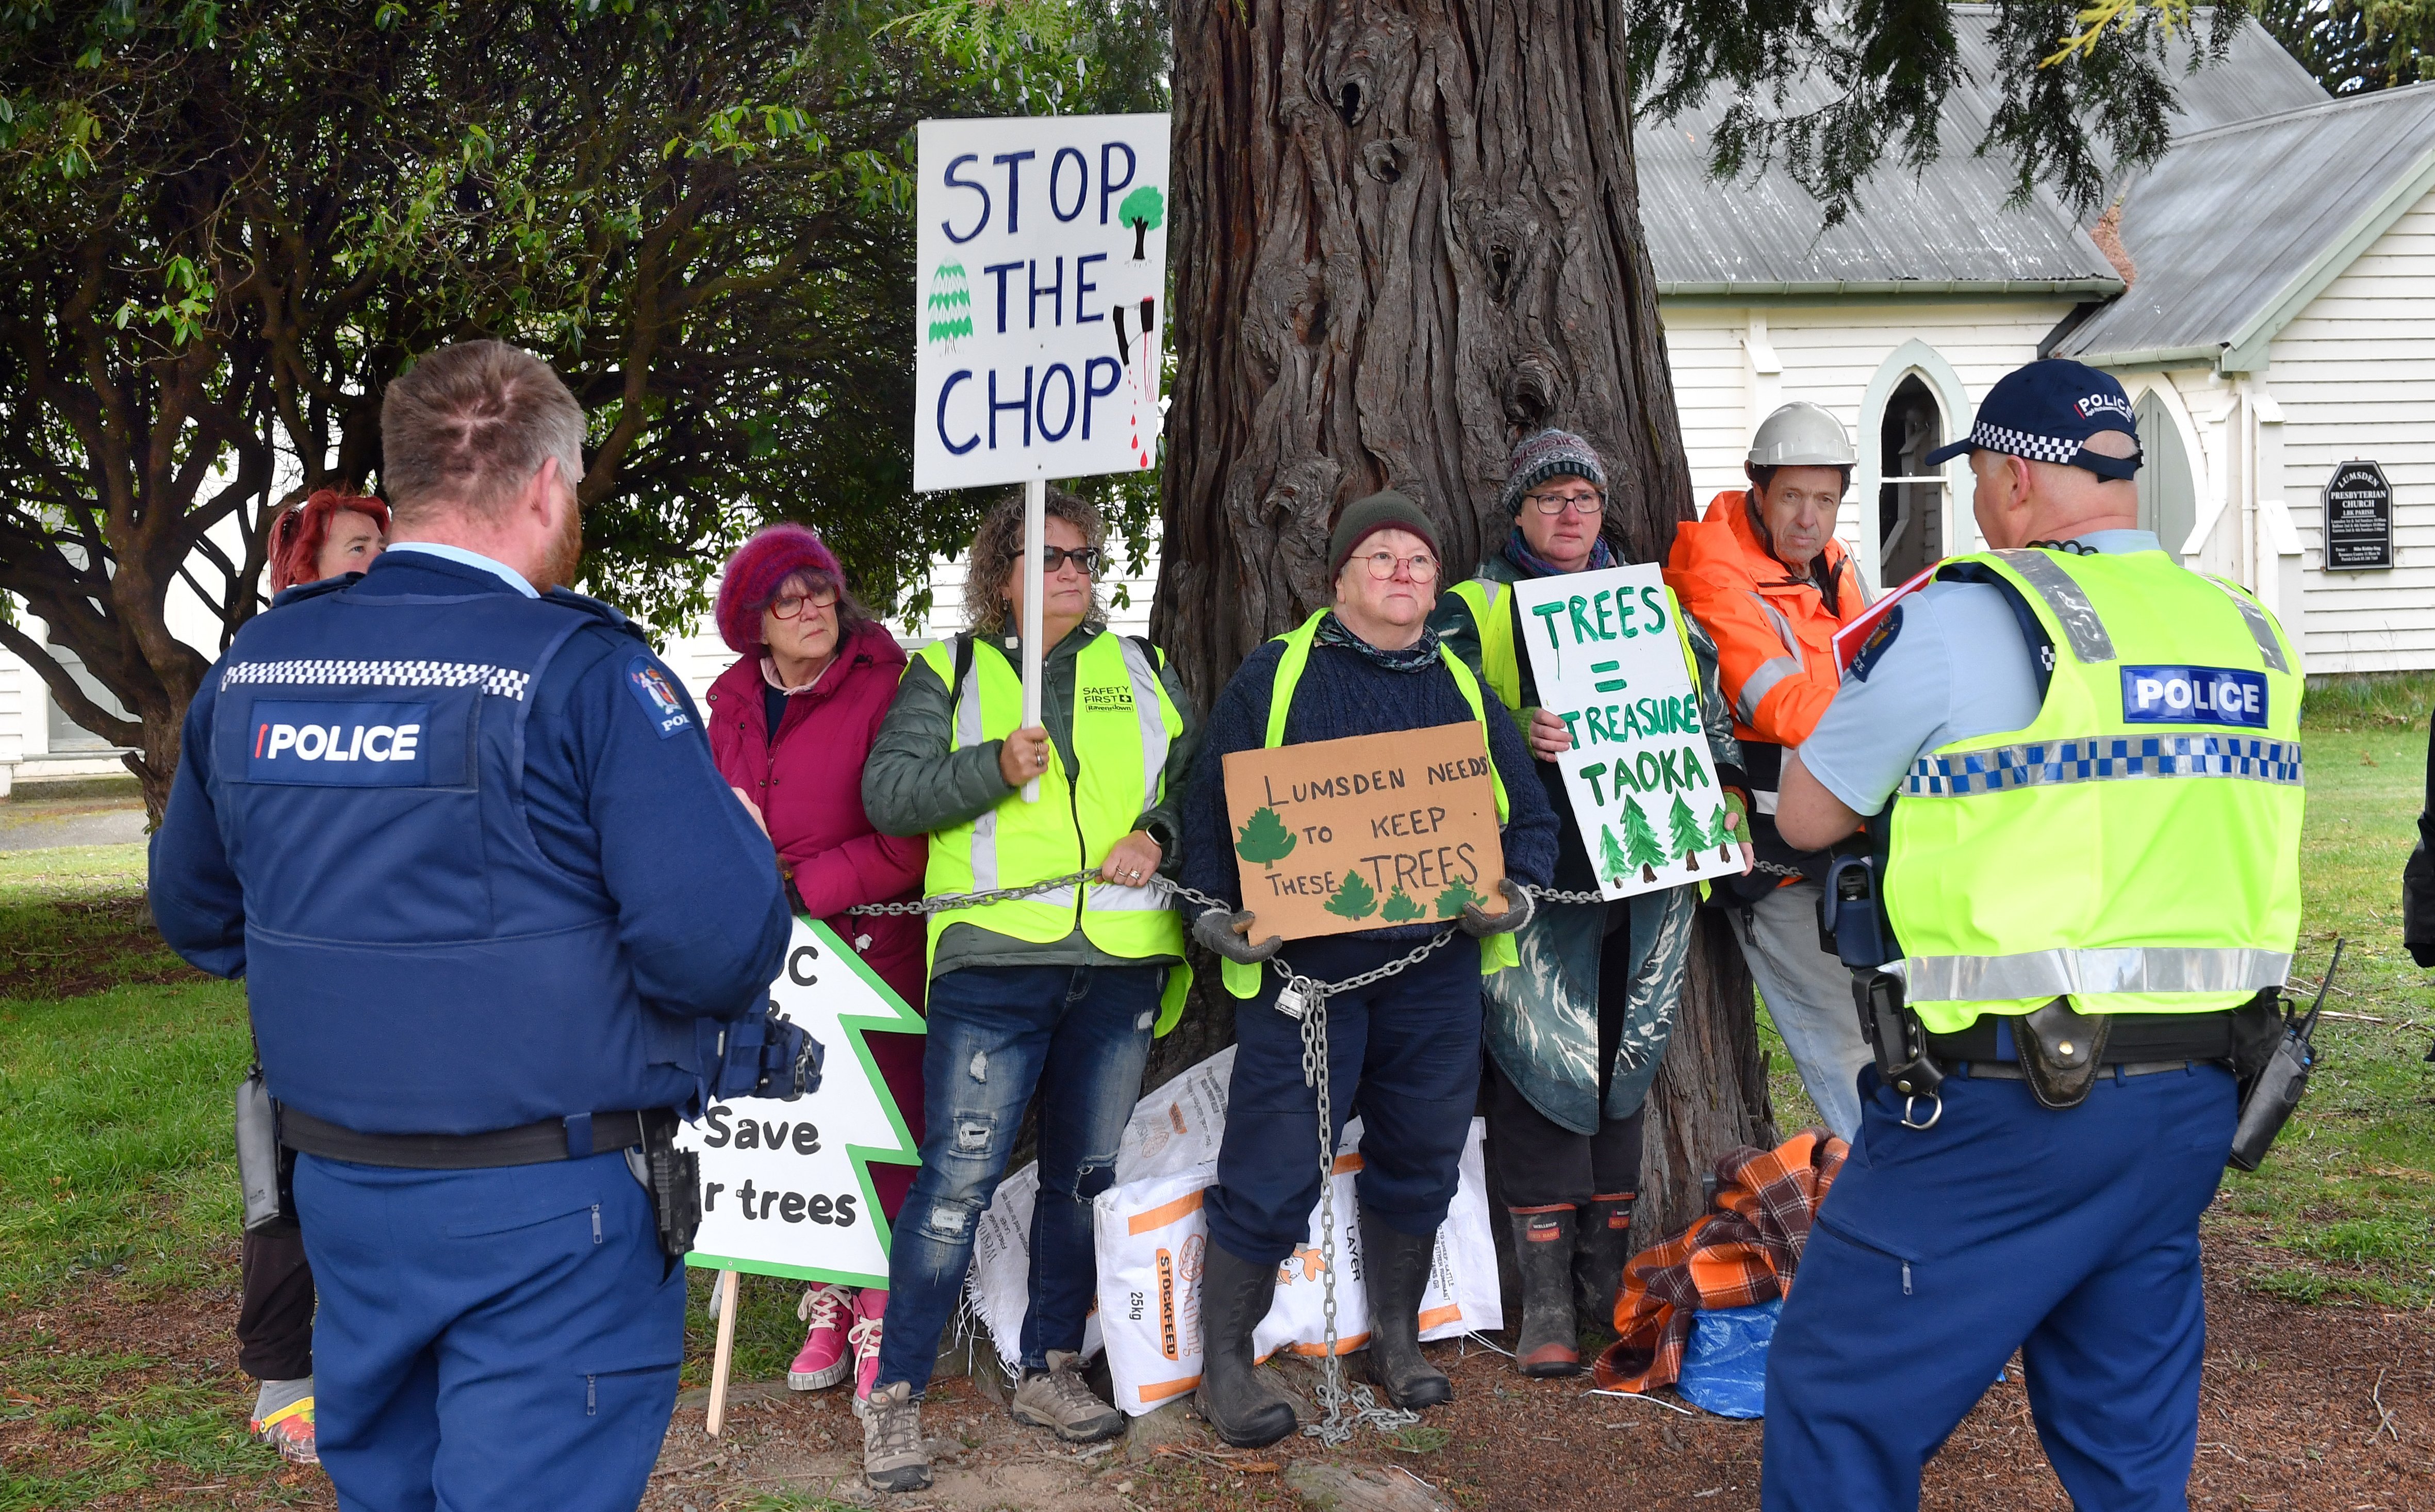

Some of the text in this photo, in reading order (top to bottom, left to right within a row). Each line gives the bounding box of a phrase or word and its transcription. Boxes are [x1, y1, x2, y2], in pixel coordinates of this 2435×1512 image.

[941, 142, 1136, 244] STOP
[983, 252, 1108, 334] THE
[937, 356, 1122, 455] CHOP
[2078, 393, 2133, 419] POLICE
[2331, 490, 2386, 500] PRESBYTERIAN
[2338, 471, 2379, 488] LUMSDEN
[2342, 499, 2374, 508] CHURCH
[1532, 586, 1666, 649] TREES
[1083, 686, 1129, 695] SAFETY
[1084, 695, 1117, 703] FIRST
[2136, 679, 2260, 714] POLICE
[268, 724, 420, 762] POLICE
[1558, 694, 1701, 750] TREASURE
[1264, 755, 1488, 807] LUMSDEN NEEDS
[1580, 746, 1709, 807] TAOKA
[1302, 807, 1446, 845] TO KEEP
[1265, 842, 1478, 896] THESE TREES
[704, 1106, 821, 1155] Save
[736, 1179, 857, 1227] trees
[1346, 1225, 1360, 1282] LAYER
[1445, 1263, 1454, 1287] CATTLE
[1129, 1292, 1144, 1321] 25kg
[1160, 1256, 1175, 1354] STOCKFEED
[1181, 1288, 1202, 1357] Milling
